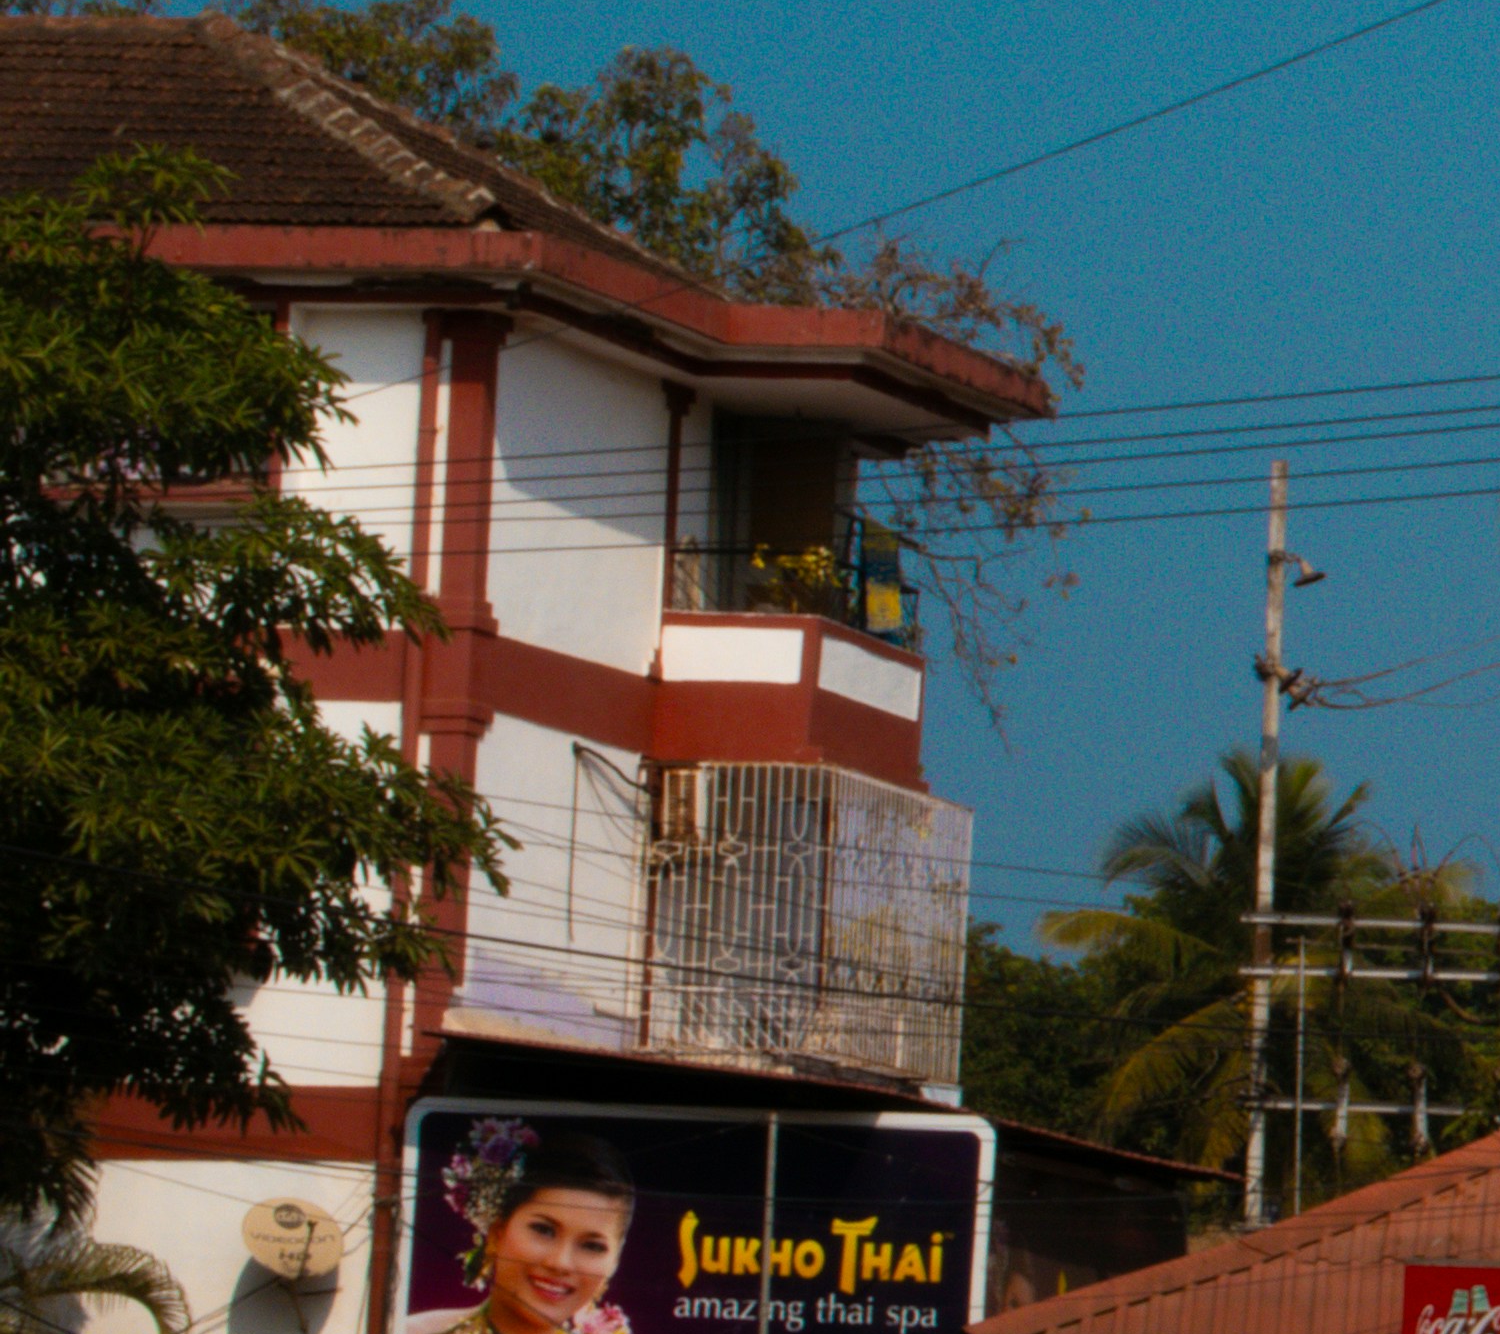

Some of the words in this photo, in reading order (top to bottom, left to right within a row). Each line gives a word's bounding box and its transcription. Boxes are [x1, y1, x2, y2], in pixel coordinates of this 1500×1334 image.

[678, 1210, 825, 1289] SUKHO
[673, 1295, 806, 1332] amazng
[815, 1293, 875, 1325] thai
